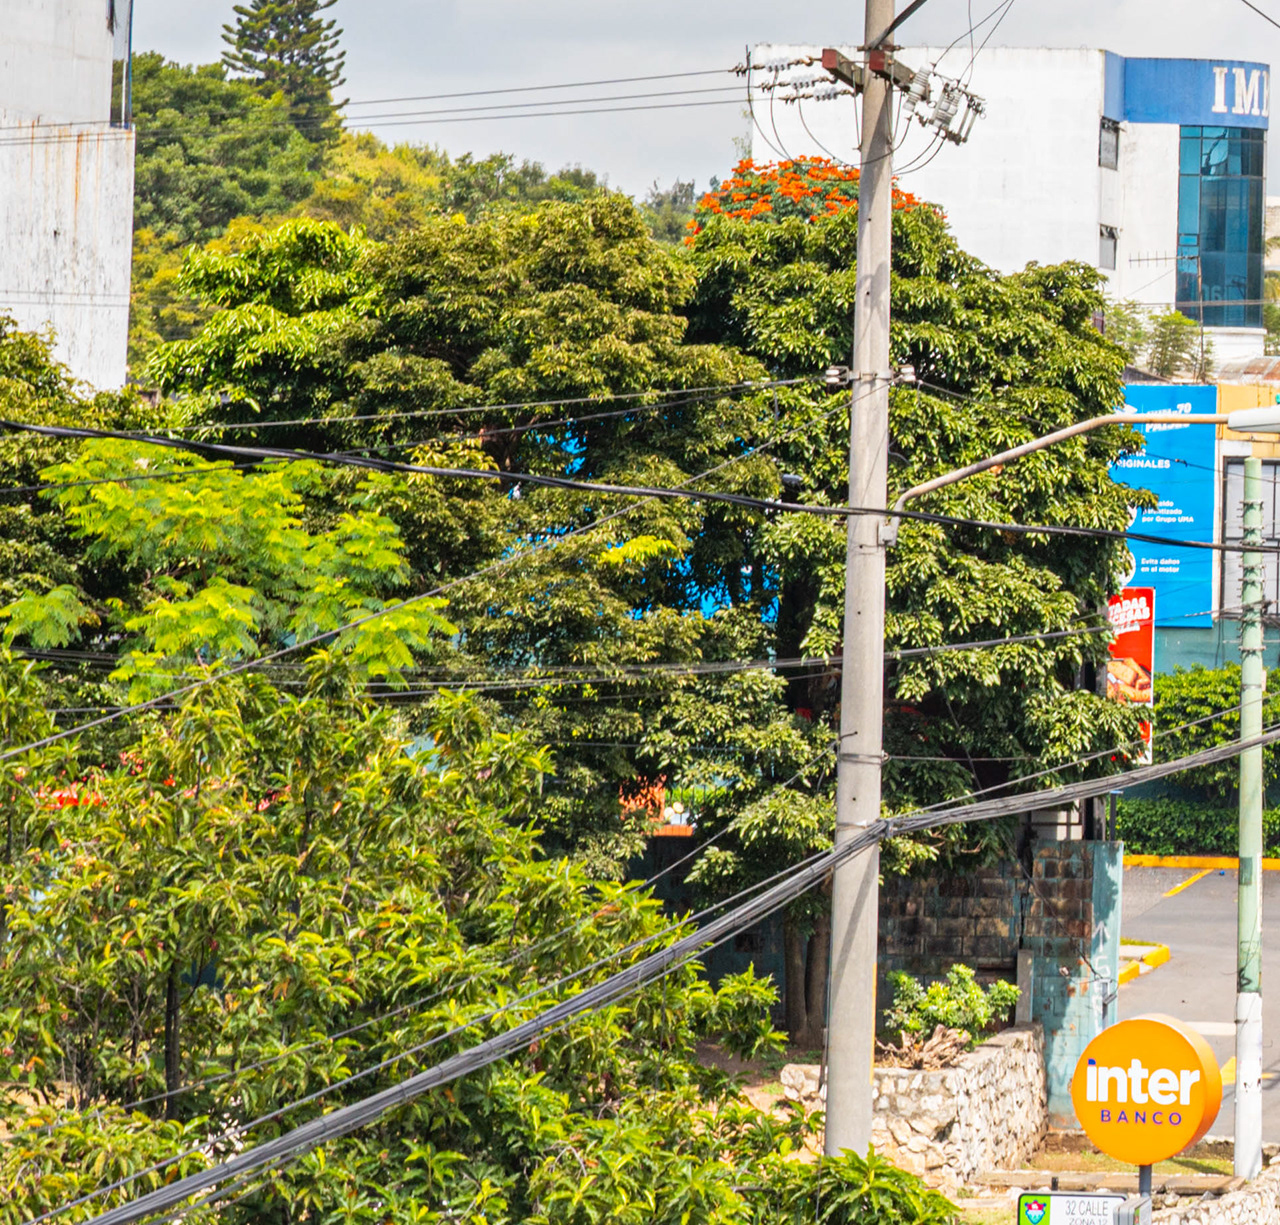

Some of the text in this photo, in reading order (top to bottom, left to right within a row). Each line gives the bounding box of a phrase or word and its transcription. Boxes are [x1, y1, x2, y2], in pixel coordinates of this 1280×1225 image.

[1087, 1058, 1200, 1105] inter
[1101, 1110, 1182, 1125] BANCO
[1066, 1201, 1108, 1216] 32 CALLE
